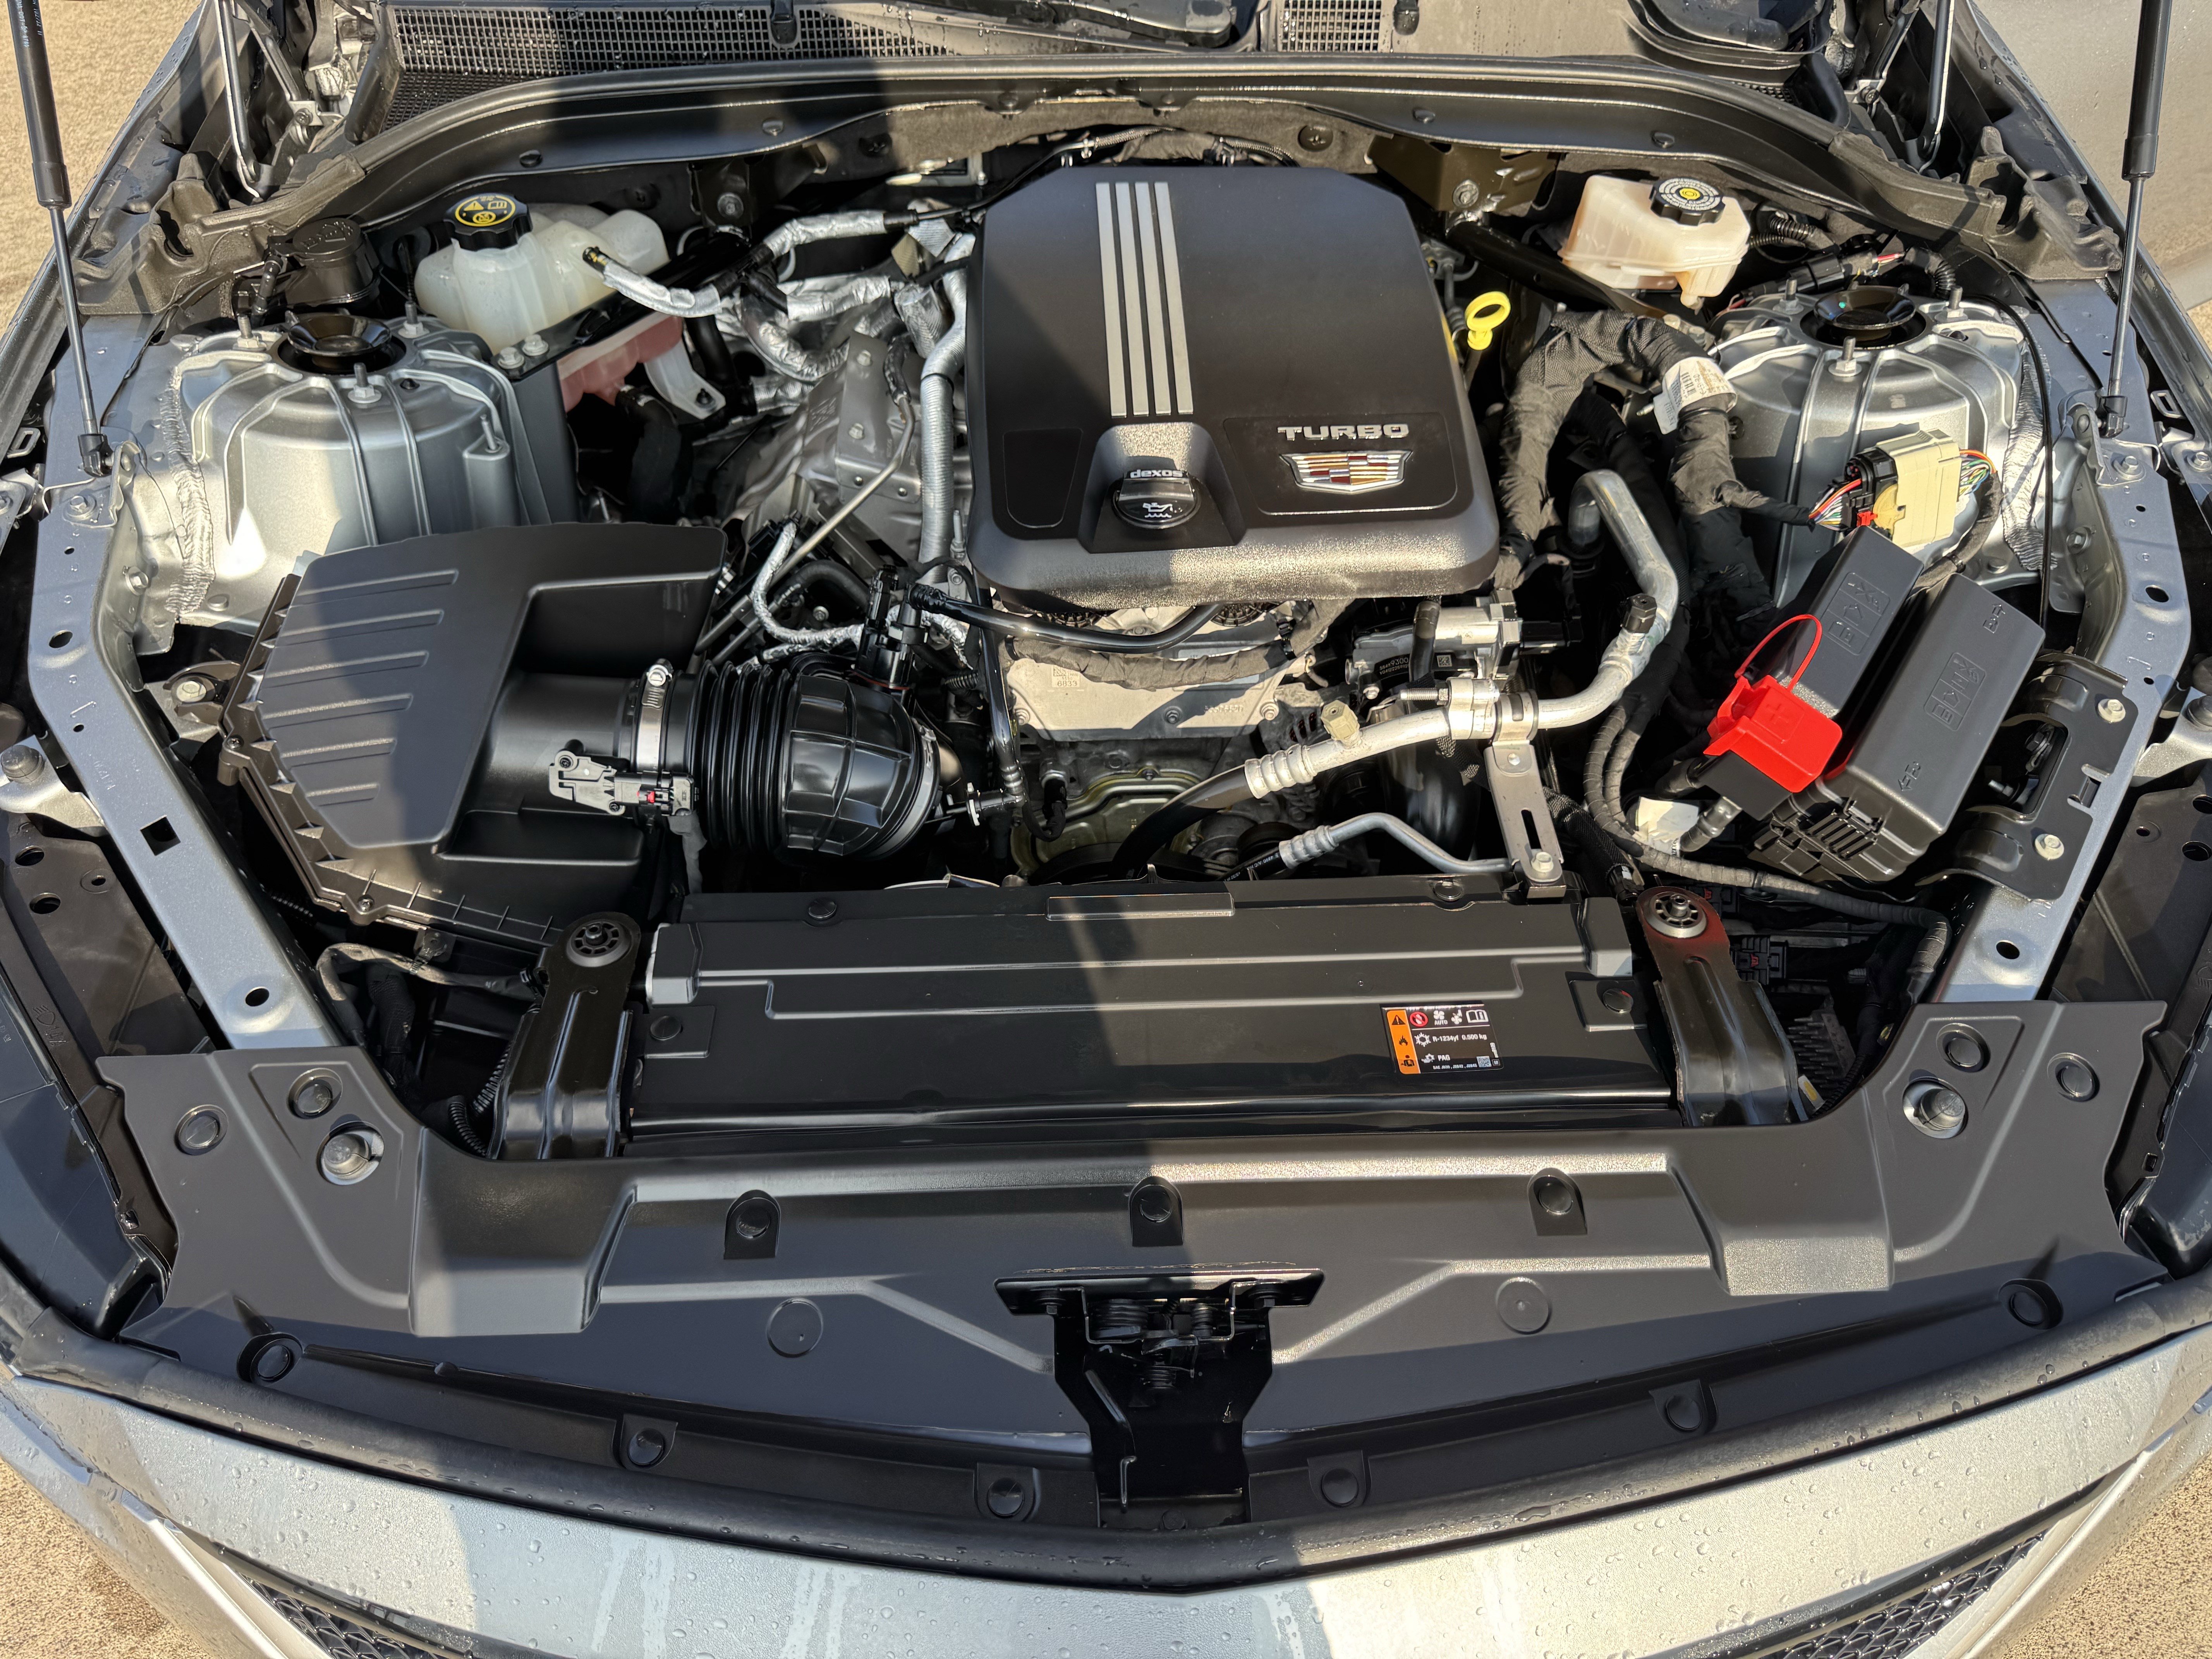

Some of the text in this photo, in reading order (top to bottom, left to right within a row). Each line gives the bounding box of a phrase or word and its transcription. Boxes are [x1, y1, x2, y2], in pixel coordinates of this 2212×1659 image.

[1277, 424, 1409, 441] TURBO
[1130, 469, 1183, 478] dexos
[1432, 1034, 1459, 1042] R-1234yf
